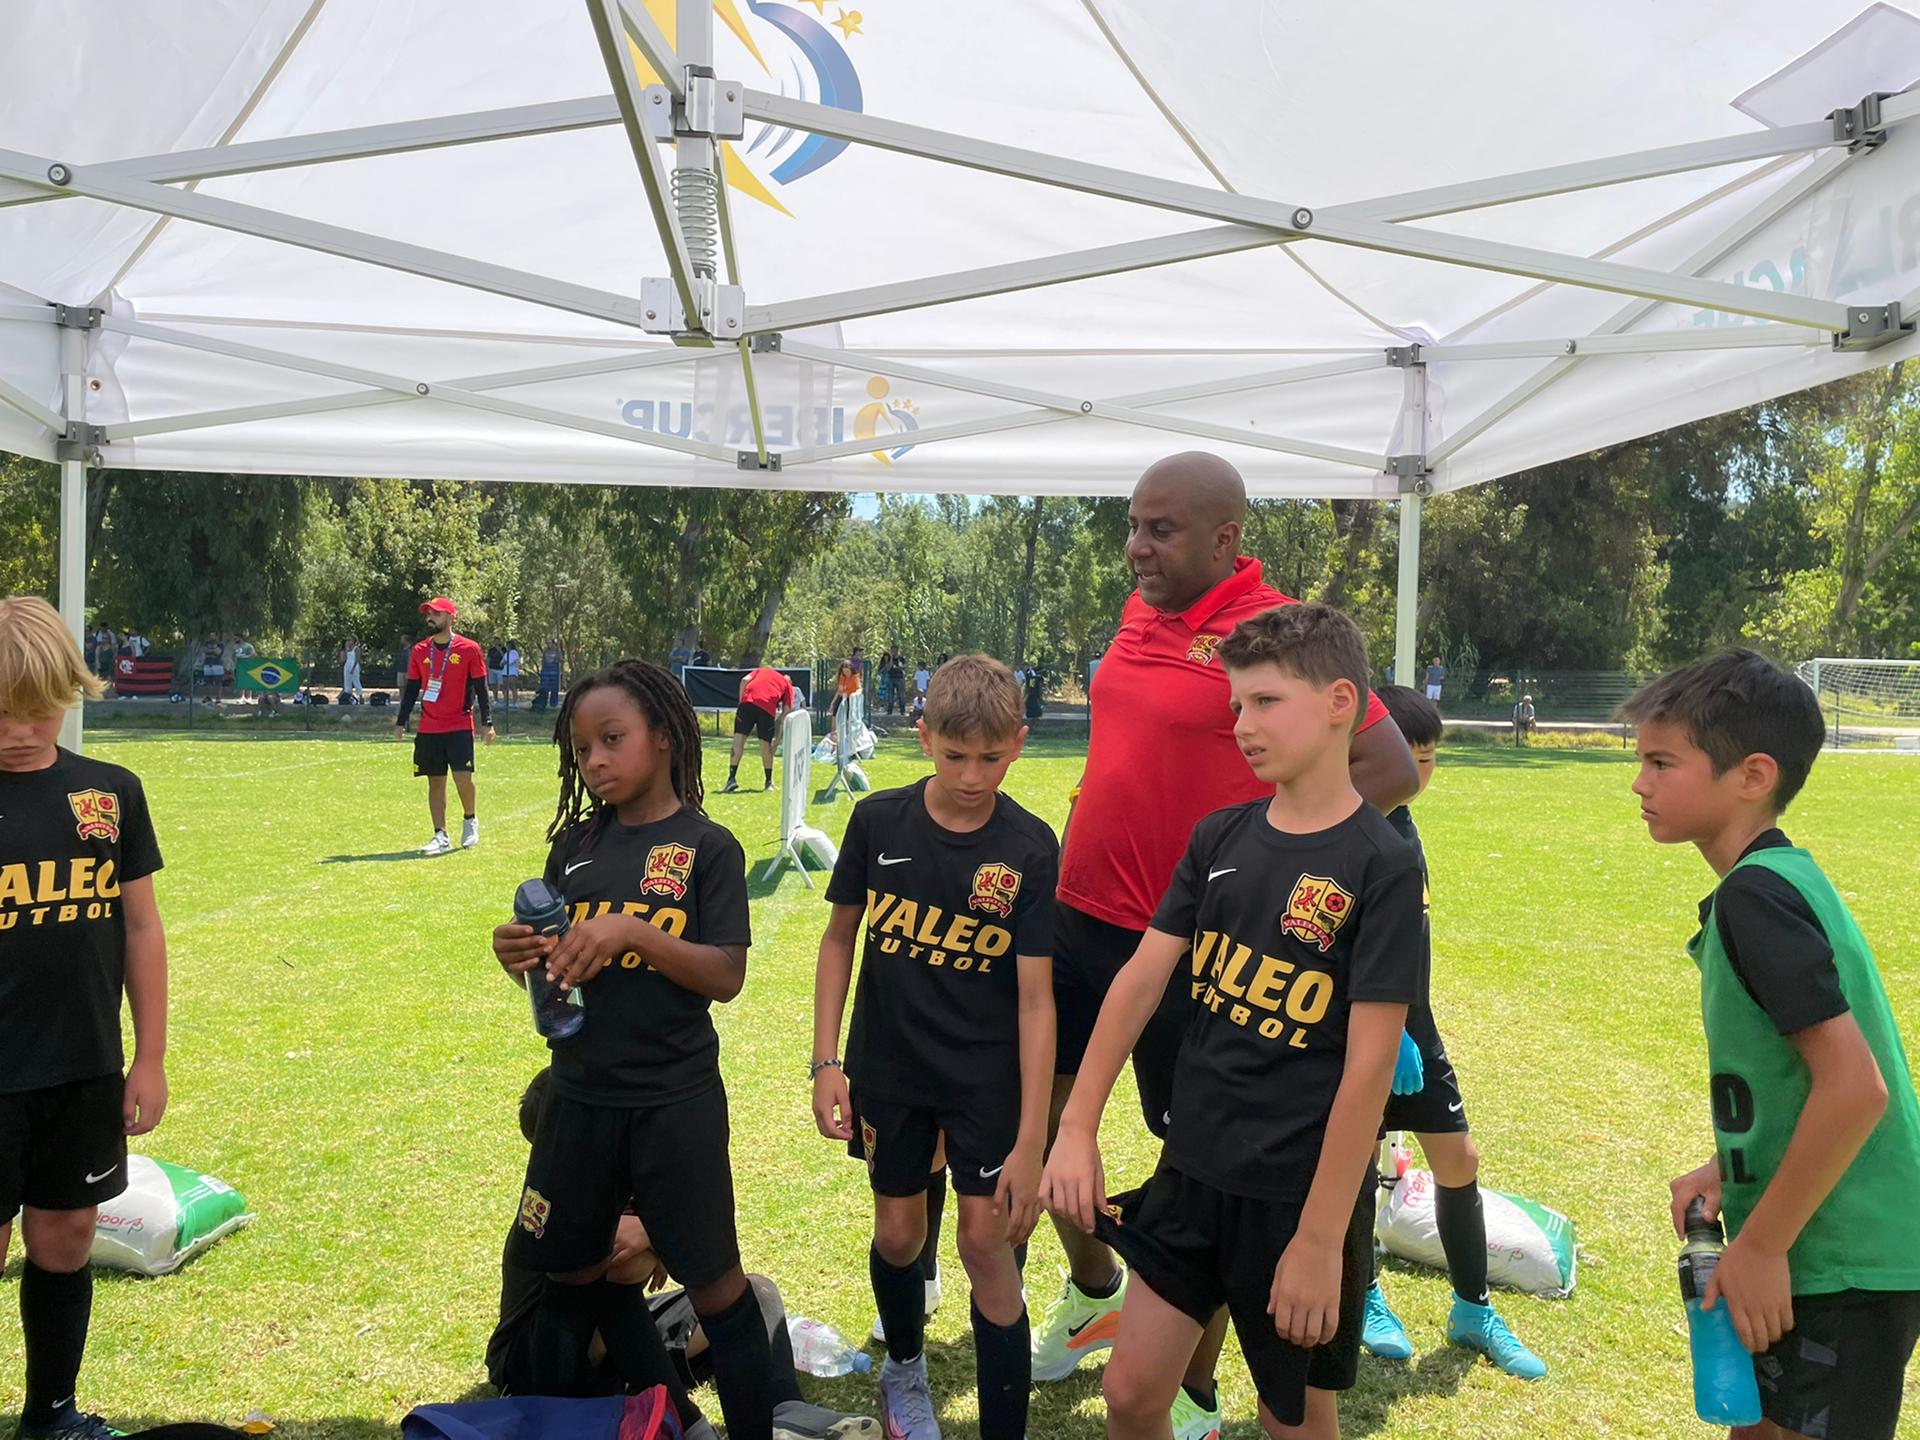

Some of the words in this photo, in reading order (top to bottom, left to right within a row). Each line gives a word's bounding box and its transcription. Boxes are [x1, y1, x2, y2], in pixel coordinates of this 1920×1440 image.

[0, 857, 121, 908] ALEO
[0, 902, 113, 931] UTBOL
[867, 888, 1012, 957] VALEO
[1192, 927, 1334, 1024] VALEO
[1191, 981, 1308, 1049] FUTBOL
